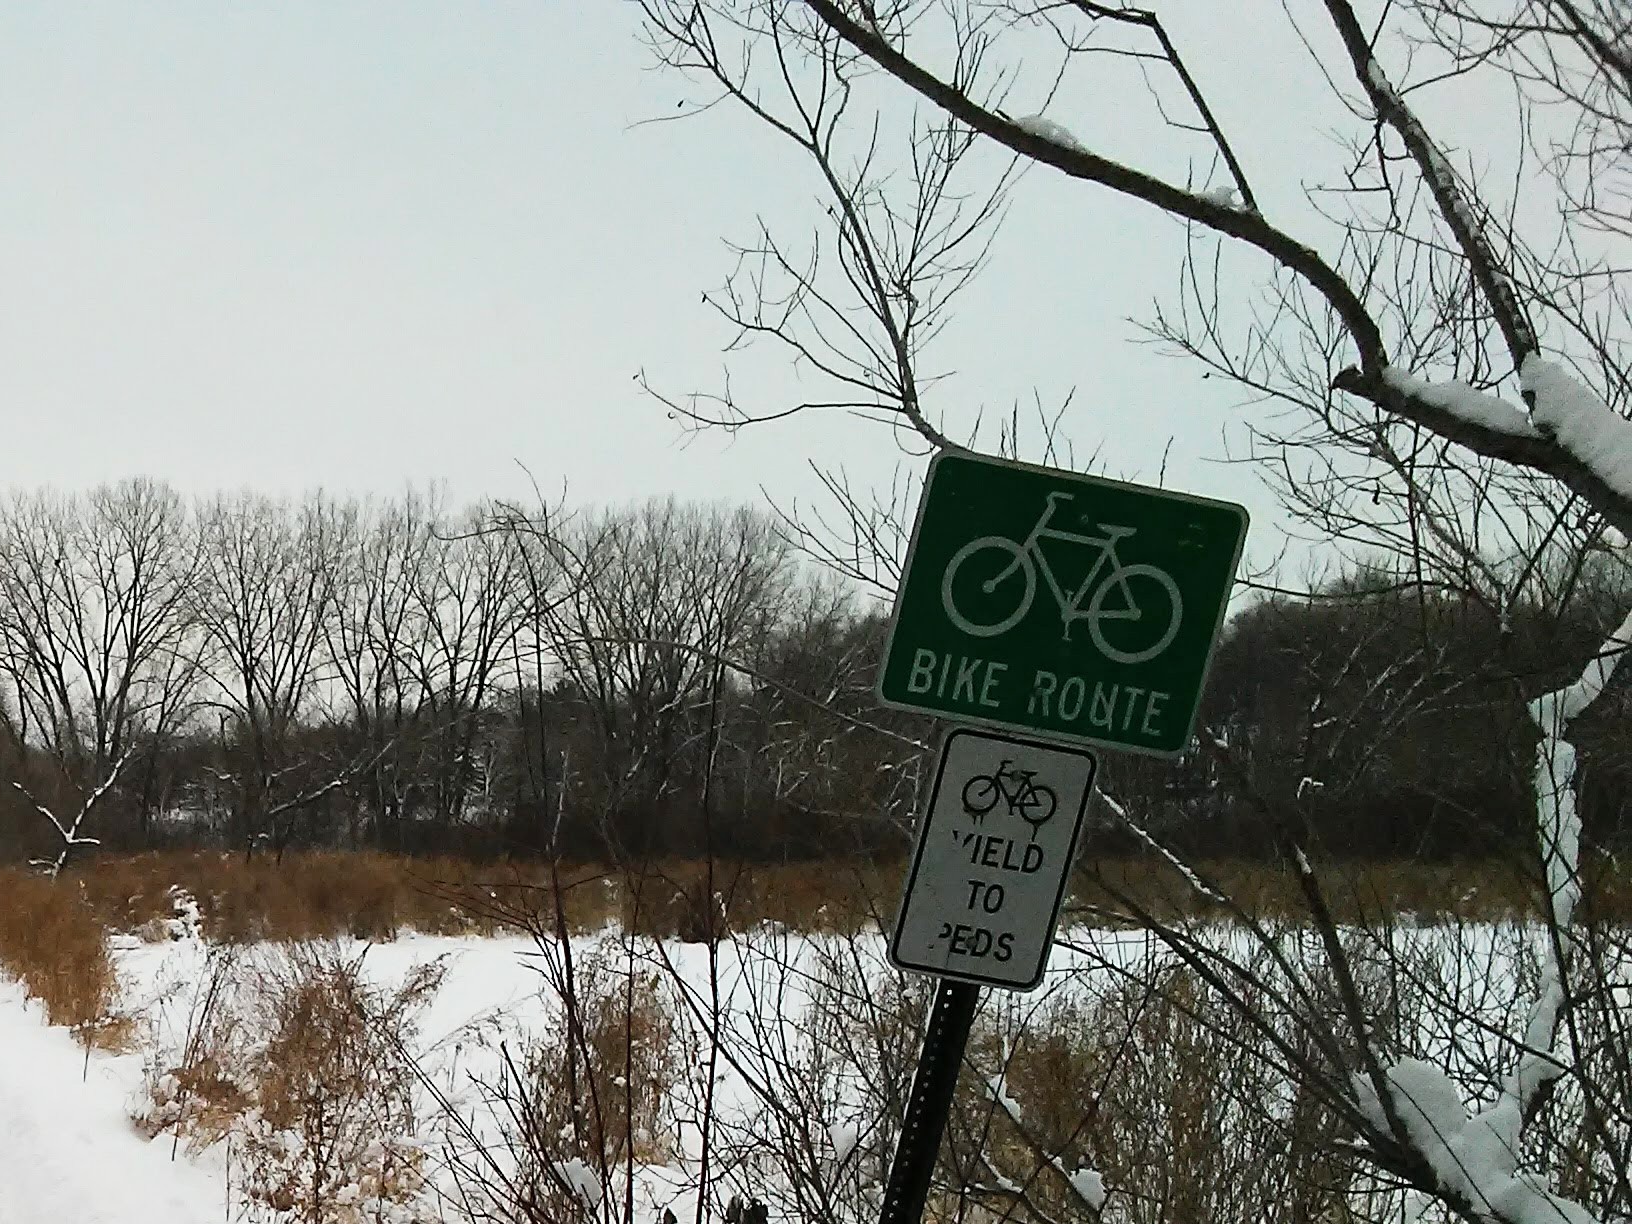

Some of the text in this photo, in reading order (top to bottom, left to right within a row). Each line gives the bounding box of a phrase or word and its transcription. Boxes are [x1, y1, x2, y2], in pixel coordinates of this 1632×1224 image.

[907, 648, 1171, 737] BIKE ROUTE
[968, 880, 1005, 914] TO
